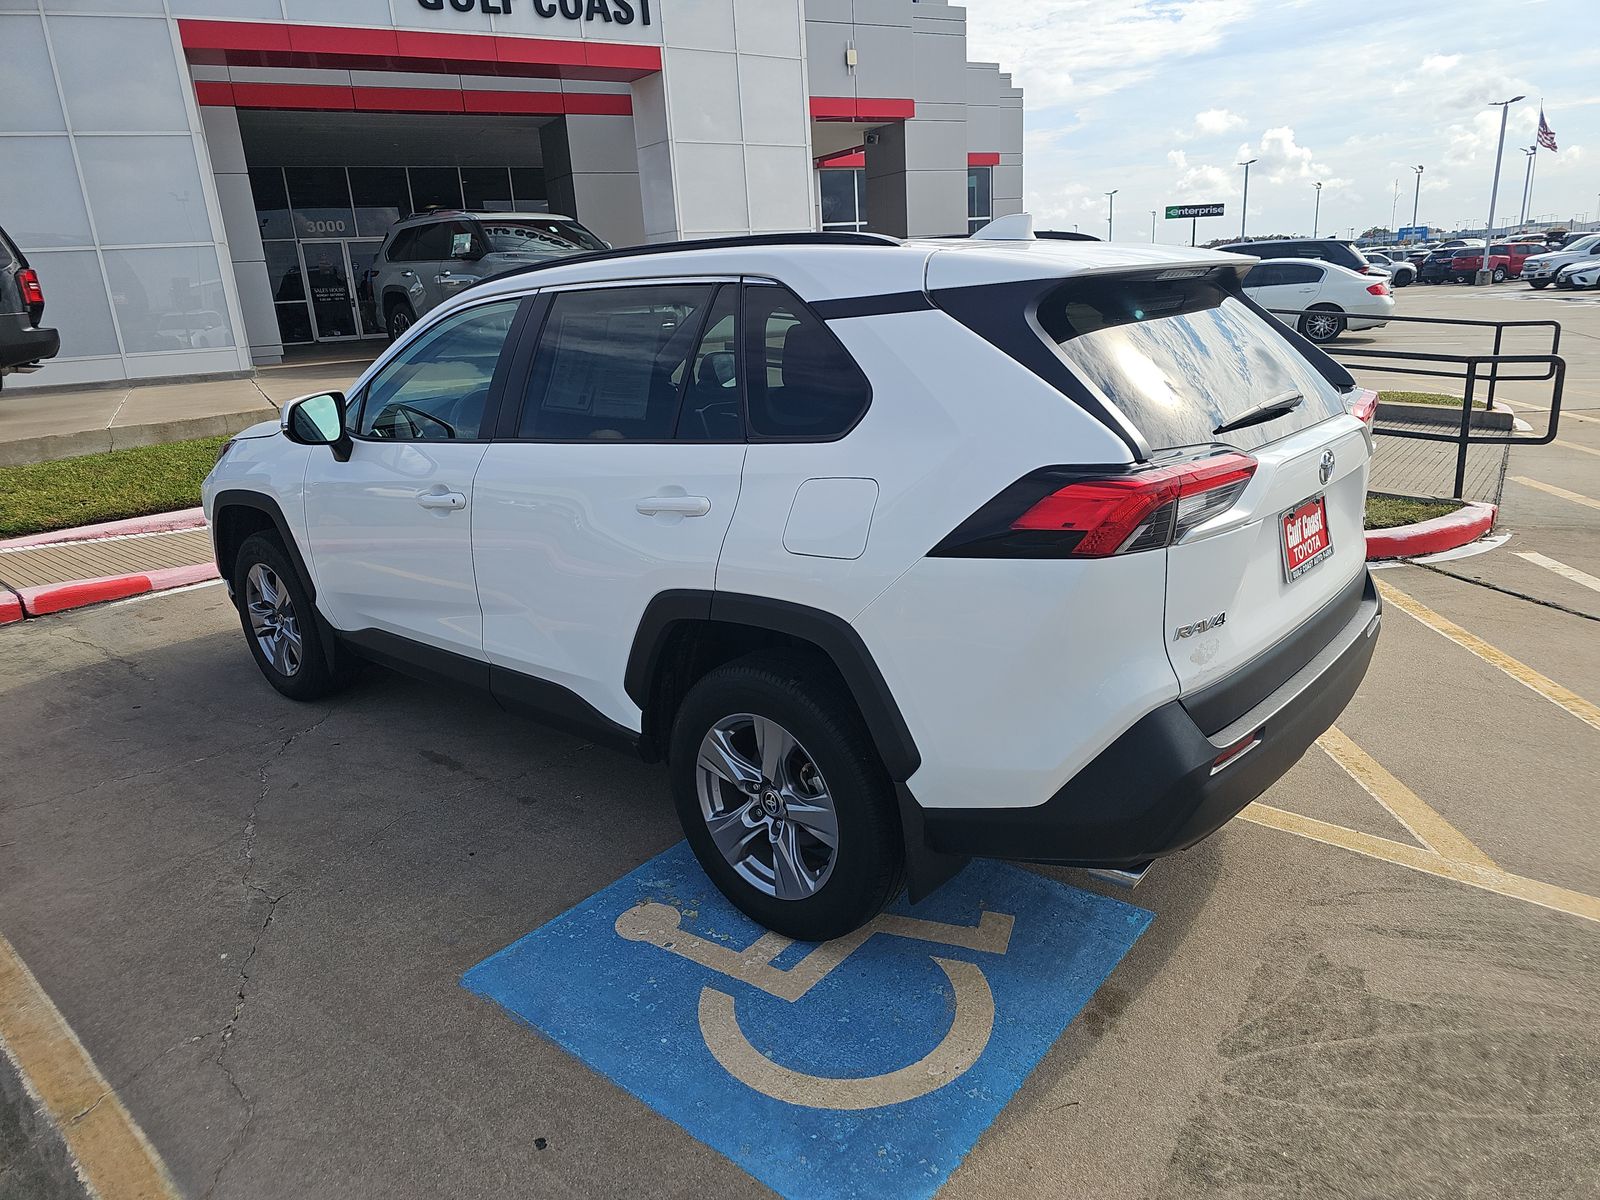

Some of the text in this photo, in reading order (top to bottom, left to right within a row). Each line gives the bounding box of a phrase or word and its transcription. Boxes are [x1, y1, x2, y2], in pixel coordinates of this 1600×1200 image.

[1168, 205, 1224, 216] enterprise
[306, 220, 346, 232] 3000
[1287, 507, 1323, 548] Gulf Coast
[1293, 535, 1322, 562] TOYOTA
[1173, 610, 1227, 641] RAV4
